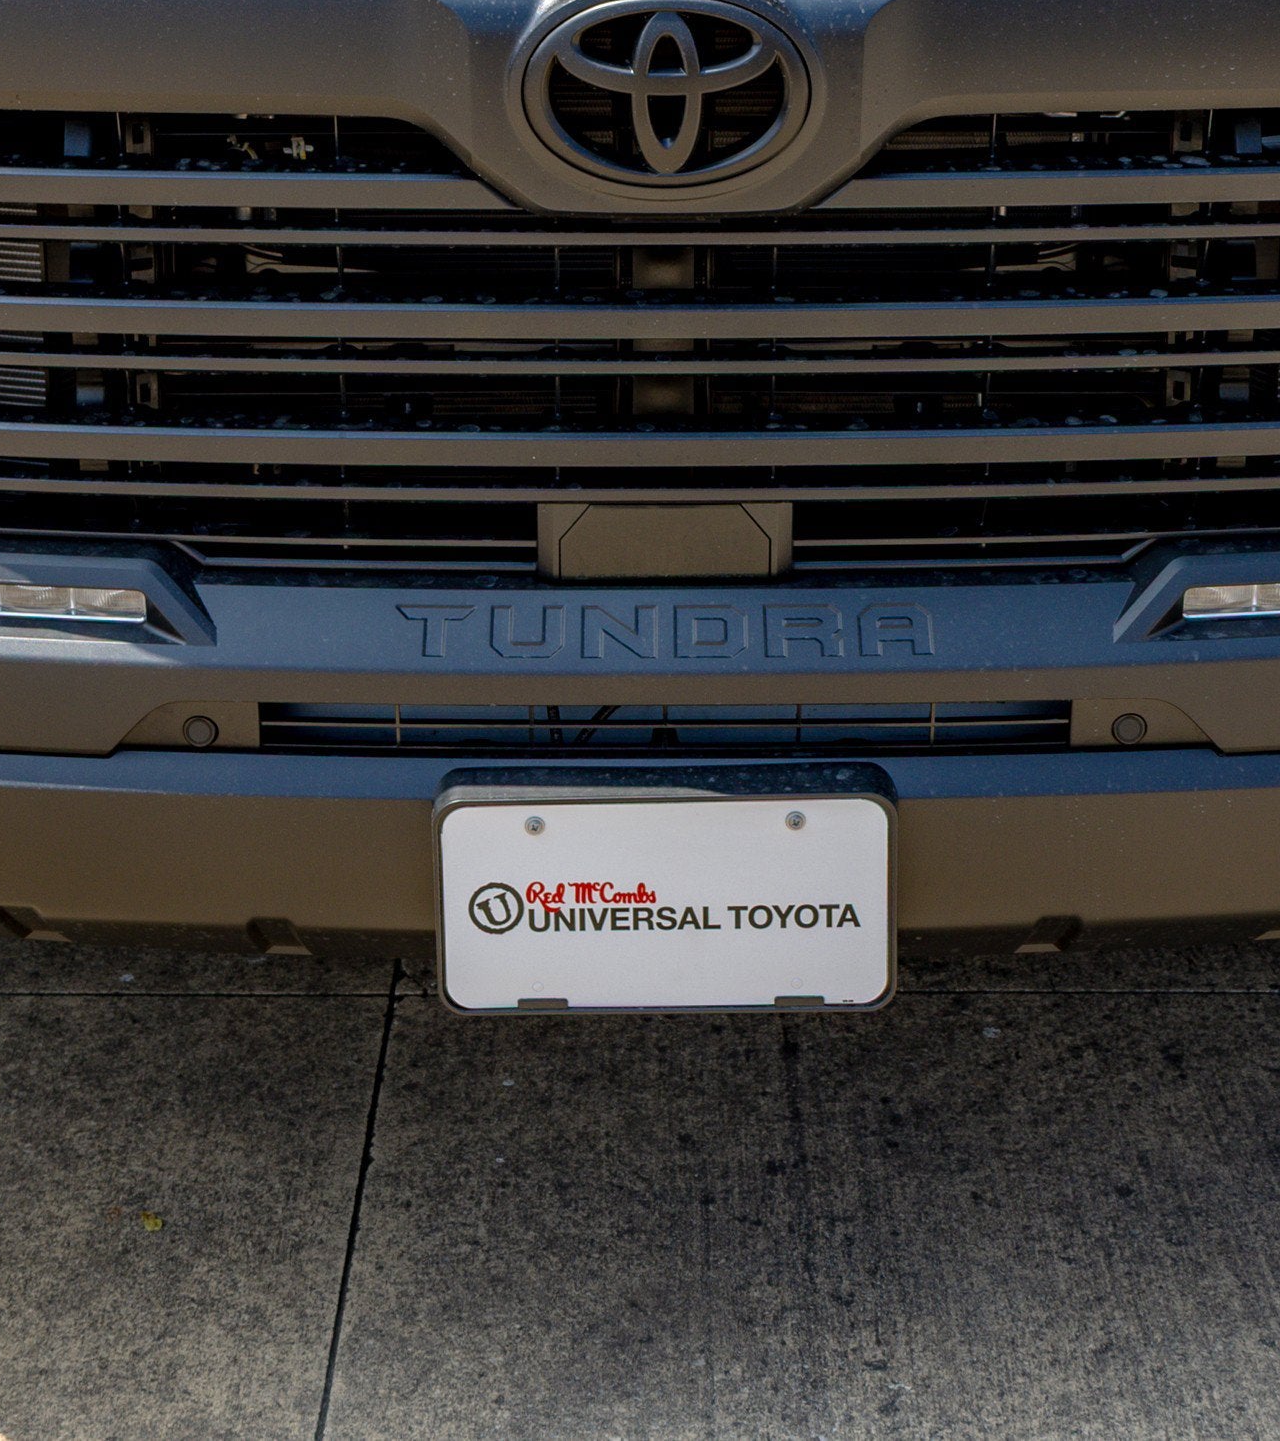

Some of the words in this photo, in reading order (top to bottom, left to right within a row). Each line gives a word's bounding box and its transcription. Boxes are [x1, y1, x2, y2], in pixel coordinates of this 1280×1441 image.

[395, 602, 935, 659] TUNDRA
[526, 882, 566, 913] Red
[569, 882, 657, 904] McCombs
[528, 906, 721, 932] UNIVERSAL
[728, 904, 861, 929] TOYOTA
